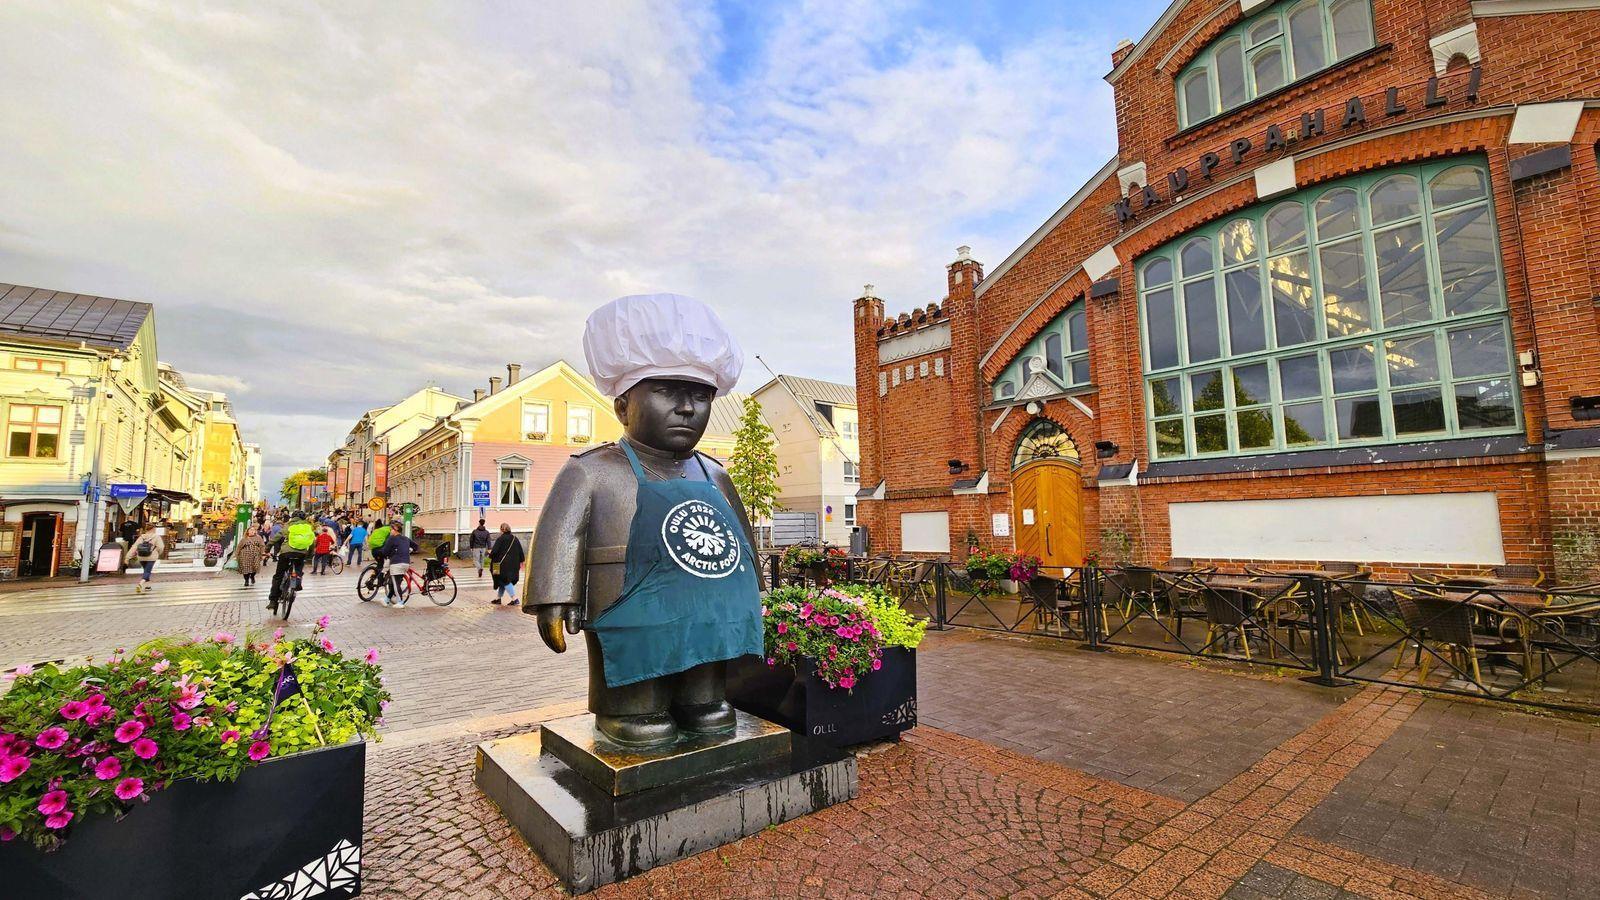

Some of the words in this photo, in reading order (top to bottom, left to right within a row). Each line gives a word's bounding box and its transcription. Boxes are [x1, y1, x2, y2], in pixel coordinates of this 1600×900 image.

[1114, 67, 1482, 224] KAUPPAHALLI
[669, 509, 689, 533] OULU
[690, 505, 714, 516] 2026
[681, 552, 718, 571] ARCTIC
[719, 549, 737, 570] FOOD
